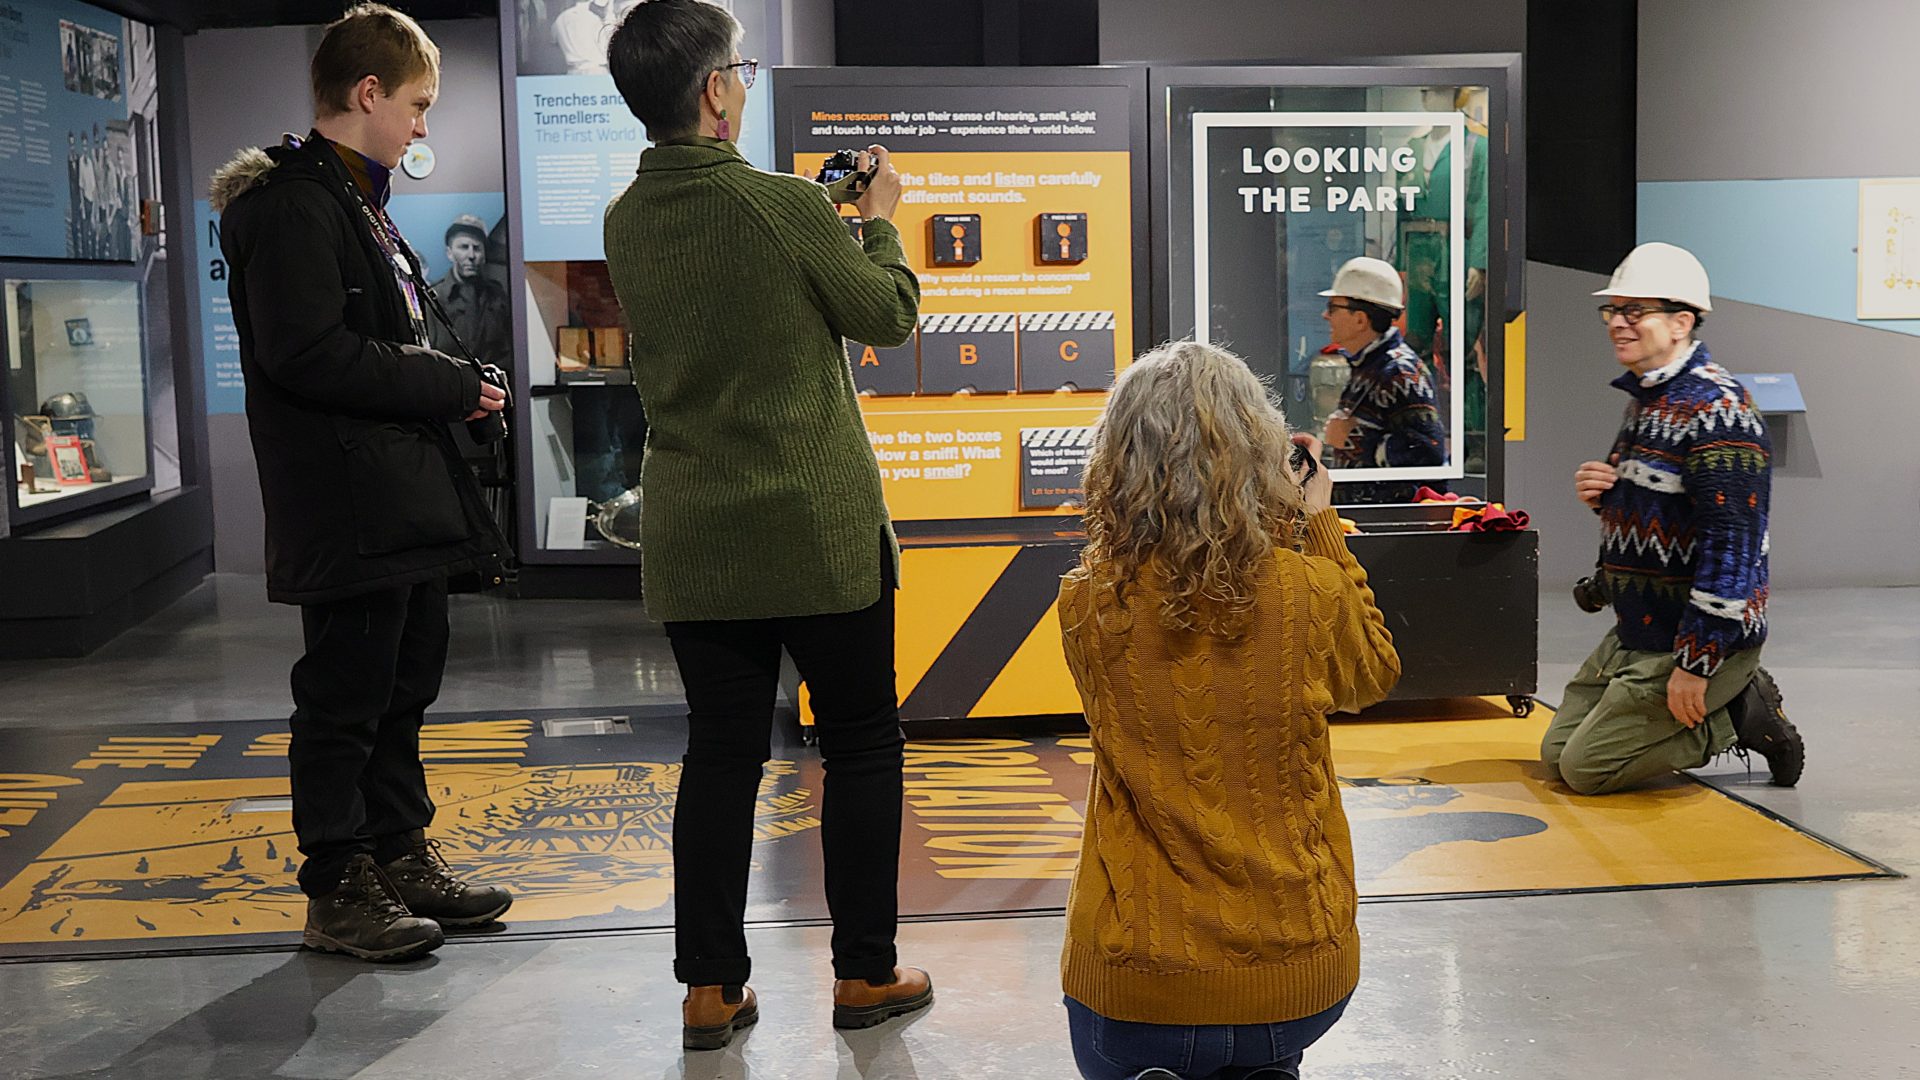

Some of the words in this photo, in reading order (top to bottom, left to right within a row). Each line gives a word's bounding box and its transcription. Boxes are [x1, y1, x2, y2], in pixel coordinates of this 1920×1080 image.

[534, 93, 597, 107] Trenches
[535, 111, 610, 125] Tunnellers:
[811, 111, 843, 121] Mines
[844, 111, 889, 121] rescuers
[891, 111, 911, 123] rely
[911, 112, 926, 121] on
[927, 111, 951, 121] their
[952, 112, 983, 121] sense
[984, 111, 996, 121] of
[997, 111, 1038, 122] hearing,
[1039, 111, 1069, 122] smell,
[1071, 111, 1096, 122] sight
[536, 129, 560, 143] The
[564, 128, 592, 142] First
[596, 127, 636, 142] World
[811, 124, 832, 135] and
[834, 124, 864, 135] touch
[865, 125, 877, 135] to
[878, 124, 892, 135] do
[893, 124, 918, 135] their
[918, 124, 936, 136] job
[950, 124, 1006, 136] experience
[1007, 124, 1032, 134] their
[1032, 124, 1061, 134] world
[1063, 124, 1096, 134] below.
[1242, 147, 1417, 173] LOOKING
[901, 173, 925, 186] the
[928, 172, 960, 186] tiles
[963, 172, 992, 185] and
[995, 171, 1035, 187] listen
[1038, 170, 1102, 187] carefully
[902, 189, 964, 204] different
[968, 189, 1027, 203] sounds.
[1238, 187, 1311, 213] THE
[1327, 186, 1421, 212] PART
[361, 205, 389, 246] DIGITAL
[942, 272, 972, 283] would
[982, 273, 1021, 282] rescuer
[1022, 271, 1035, 281] be
[1037, 271, 1090, 281] concerned
[949, 287, 982, 298] during
[984, 288, 991, 296] a
[992, 287, 1025, 296] rescue
[1028, 284, 1072, 295] mission?
[860, 346, 880, 366] A
[959, 344, 978, 365] B
[1059, 340, 1079, 362] C
[897, 430, 922, 444] the
[925, 430, 954, 444] two
[956, 429, 1002, 442] boxes
[909, 450, 920, 461] a
[923, 446, 959, 461] sniff!
[962, 446, 1001, 459] What
[1029, 448, 1054, 457] Which
[1054, 448, 1064, 456] of
[1064, 448, 1085, 456] these
[1030, 457, 1054, 466] would
[1055, 457, 1076, 466] alarm
[892, 467, 920, 481] you
[923, 463, 972, 480] smell?
[1030, 467, 1044, 475] the
[1044, 466, 1069, 475] most?
[72, 734, 223, 769] THE
